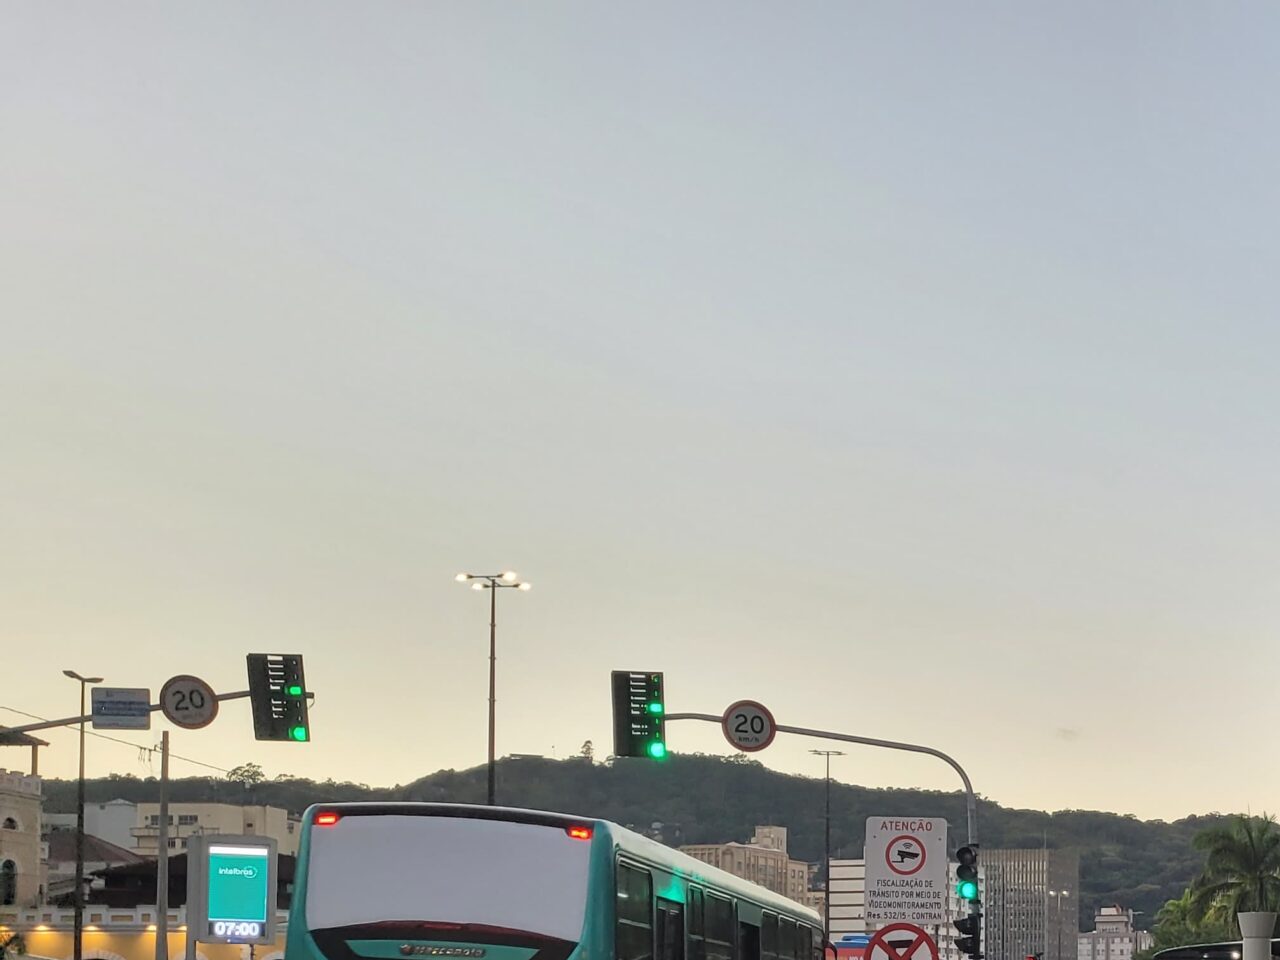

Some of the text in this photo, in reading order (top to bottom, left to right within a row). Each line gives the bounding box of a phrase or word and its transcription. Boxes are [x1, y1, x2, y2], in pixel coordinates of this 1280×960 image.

[172, 689, 205, 712] 20
[734, 713, 765, 734] 20
[880, 819, 933, 833] ATENÇÃO
[218, 866, 254, 876] intelbras
[876, 879, 934, 889] FISCALIZAÇÃO DE
[868, 889, 942, 899] TRÂNSITO POR MEIO DE
[868, 901, 942, 910] VIDEOMONITORAMENTO
[884, 912, 907, 920] 532/15
[911, 912, 942, 920] CONTRAN
[214, 921, 260, 936] 07:00
